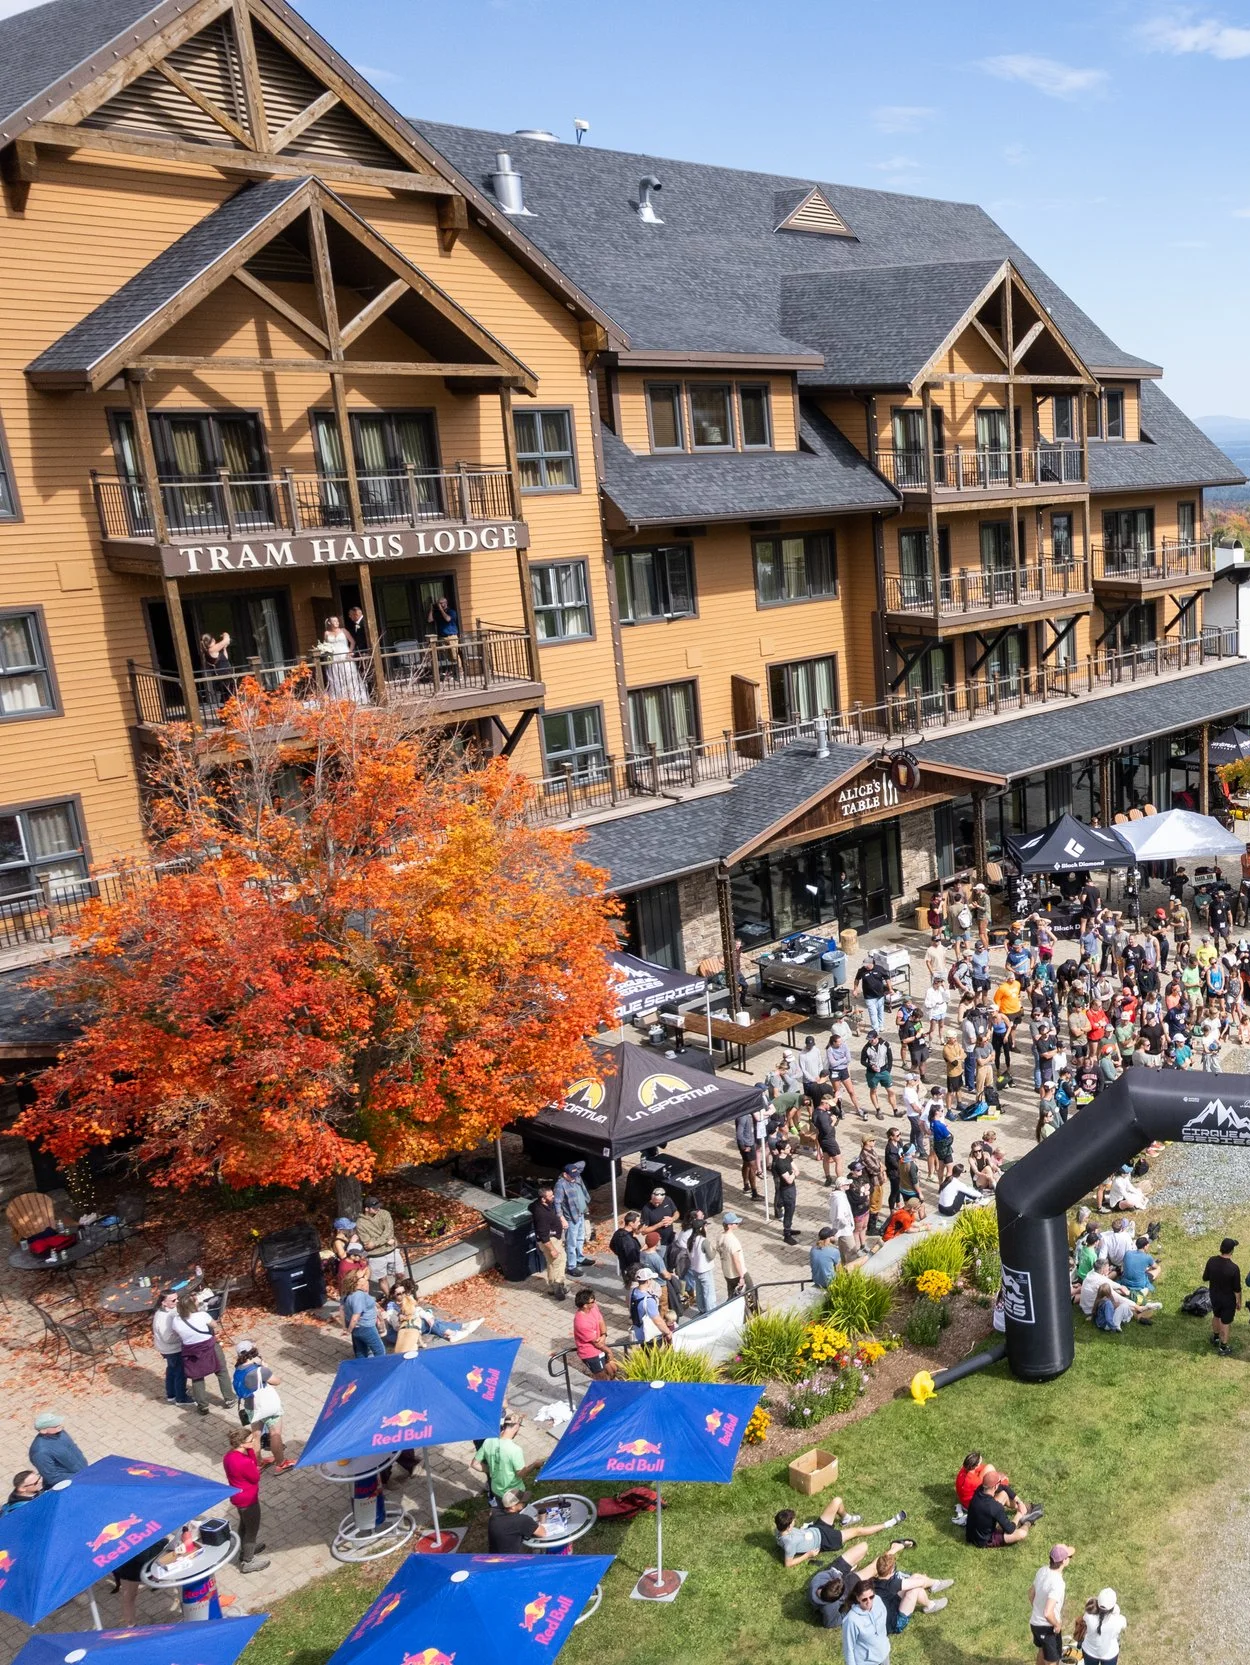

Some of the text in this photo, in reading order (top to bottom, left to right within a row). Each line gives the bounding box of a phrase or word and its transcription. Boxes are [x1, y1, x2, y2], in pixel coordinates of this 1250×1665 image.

[179, 525, 519, 573] TRAM HAUS LODGE
[838, 779, 880, 802] ALICE'S
[842, 796, 880, 816] TABLE
[1079, 860, 1104, 868] Diamond
[644, 981, 705, 1007] SERIES
[626, 1083, 719, 1122] LA SPORTIVA
[1182, 1128, 1238, 1138] CIRQUE
[482, 1368, 500, 1402] Red Bull
[372, 1426, 433, 1446] Red Bull
[718, 1413, 739, 1447] Red Bull
[607, 1458, 665, 1472] Red Bull
[93, 1520, 162, 1567] Red Bull
[534, 1595, 574, 1646] Red Bull
